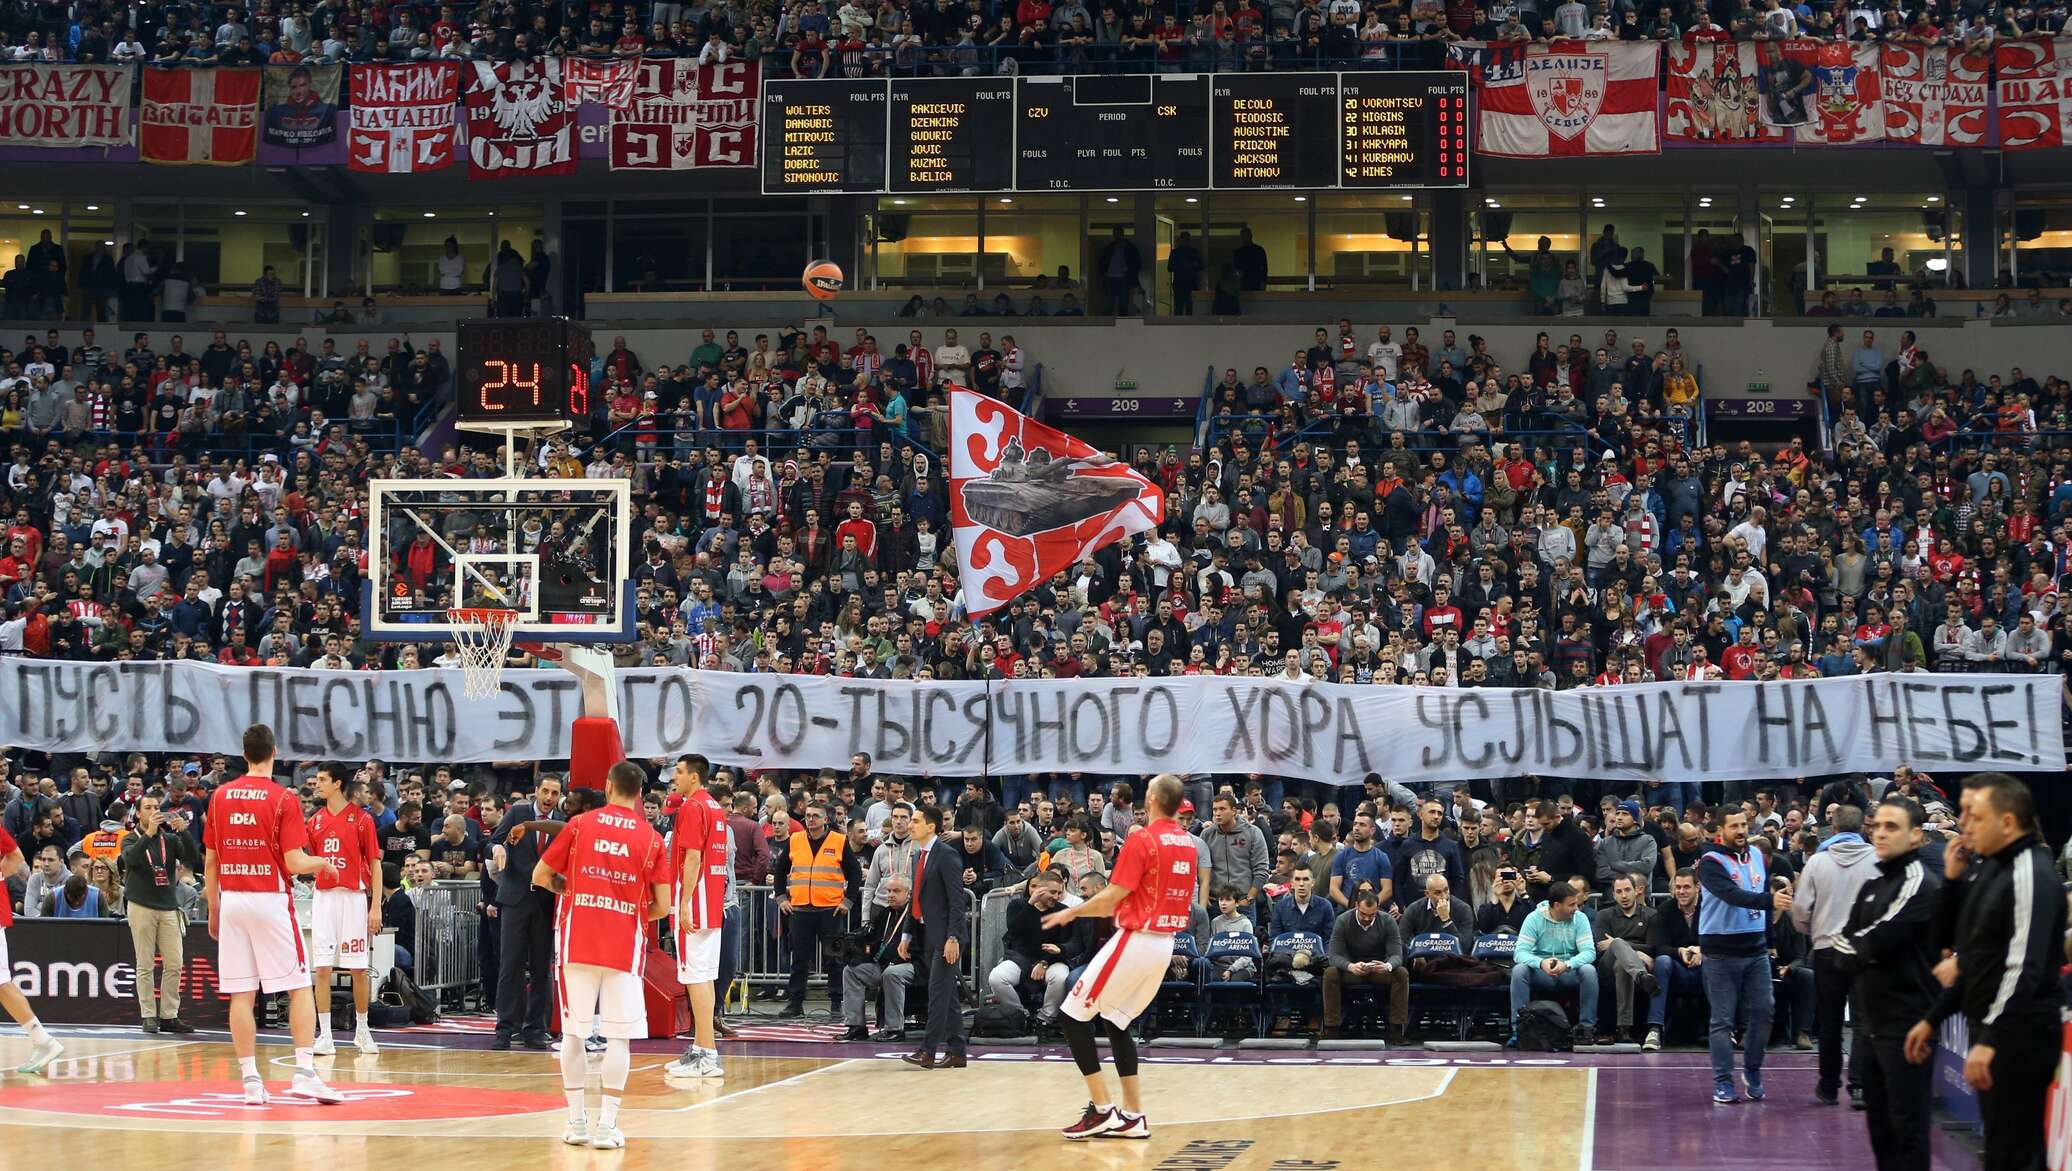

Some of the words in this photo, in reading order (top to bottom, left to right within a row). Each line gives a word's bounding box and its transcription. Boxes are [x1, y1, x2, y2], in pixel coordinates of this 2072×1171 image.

[1528, 58, 1604, 71] ДЕЛИЈЕ
[1214, 89, 1231, 97] PLYR
[1299, 87, 1318, 95] FOUL
[1321, 87, 1335, 95] PTS
[1343, 87, 1359, 95] PLYR
[1428, 86, 1447, 94] FOUL
[1450, 86, 1464, 94] PTS
[1536, 89, 1547, 98] 19
[1585, 89, 1598, 98] 89
[767, 94, 783, 102] PLYR
[850, 93, 869, 101] FOUL
[871, 93, 885, 101] PTS
[893, 93, 908, 101] PLYR
[976, 92, 994, 100] FOUL
[996, 91, 1010, 99] PTS
[1345, 100, 1357, 109] 20
[1362, 98, 1423, 108] VORONTSEV
[1440, 98, 1447, 108] 0
[1456, 98, 1463, 108] 0
[144, 103, 255, 125] BRIGATE
[470, 106, 490, 120] 19
[785, 106, 830, 115] WOLTERS
[911, 104, 965, 114] RAKICEVIC
[1028, 108, 1049, 118] CZV
[1157, 106, 1177, 116] CSK
[1098, 113, 1126, 121] PERIOD
[1234, 113, 1284, 123] TEODOSIC
[1345, 113, 1357, 122] 22
[1362, 112, 1404, 121] HIGGINS
[1440, 112, 1447, 121] 0
[1456, 112, 1463, 121] 0
[1545, 114, 1590, 127] СЕВЕР
[785, 119, 832, 129] DANGUBIC
[1234, 127, 1290, 137] AUGUSTINE
[1345, 127, 1357, 136] 30
[1362, 125, 1405, 135] KULAGIN
[1440, 125, 1447, 135] 0
[1456, 125, 1463, 135] 0
[785, 132, 835, 142] MITROVIC
[910, 131, 953, 141] GUDURIC
[1234, 140, 1276, 150] FRIDZON
[1345, 140, 1357, 149] 31
[1362, 139, 1408, 149] KHRYAPA
[1440, 139, 1447, 149] 0
[1456, 139, 1463, 149] 0
[784, 146, 814, 156] LAZIC
[910, 145, 942, 154] JOVIC
[1022, 150, 1047, 158] FOULS
[1077, 149, 1096, 157] PLYR
[1103, 149, 1122, 157] FOUL
[1131, 149, 1146, 157] PTS
[1178, 148, 1202, 156] FOULS
[910, 158, 947, 168] KUZMIC
[1234, 154, 1278, 164] JACKSON
[1345, 154, 1357, 163] 41
[1362, 153, 1414, 163] KURBANOV
[1440, 153, 1447, 163] 0
[1456, 153, 1463, 163] 0
[784, 159, 820, 169] DOBRIC
[910, 172, 952, 181] BJELICA
[1234, 167, 1280, 177] ANTONOV
[1345, 168, 1357, 177] 42
[1362, 167, 1393, 176] HINES
[1440, 167, 1447, 176] 0
[1456, 167, 1463, 176] 0
[784, 173, 839, 183] SIMONOVIC
[1154, 179, 1175, 187] T.O.C.
[1050, 180, 1070, 188] T.O.C.
[481, 360, 539, 410] 24
[571, 363, 588, 415] 24
[1111, 399, 1140, 411] 209
[1261, 659, 1285, 667] HOME
[17, 662, 200, 744] ПУСТЬ
[249, 671, 455, 759] ПЕСНЮ
[494, 675, 692, 757] ЭТГО
[1224, 686, 1372, 773] ХОРА
[1416, 686, 1720, 769] УСЛЫШАТ
[1756, 682, 1840, 767] НА
[1866, 679, 2041, 765] НЕБЕ!
[226, 789, 268, 800] KUZMIC
[598, 813, 636, 830] JOVIC
[324, 838, 340, 853] 20
[581, 866, 636, 882] ACIBADEM
[575, 894, 636, 915] BELGRADE
[351, 939, 364, 952] 20
[1072, 980, 1083, 997] 3
